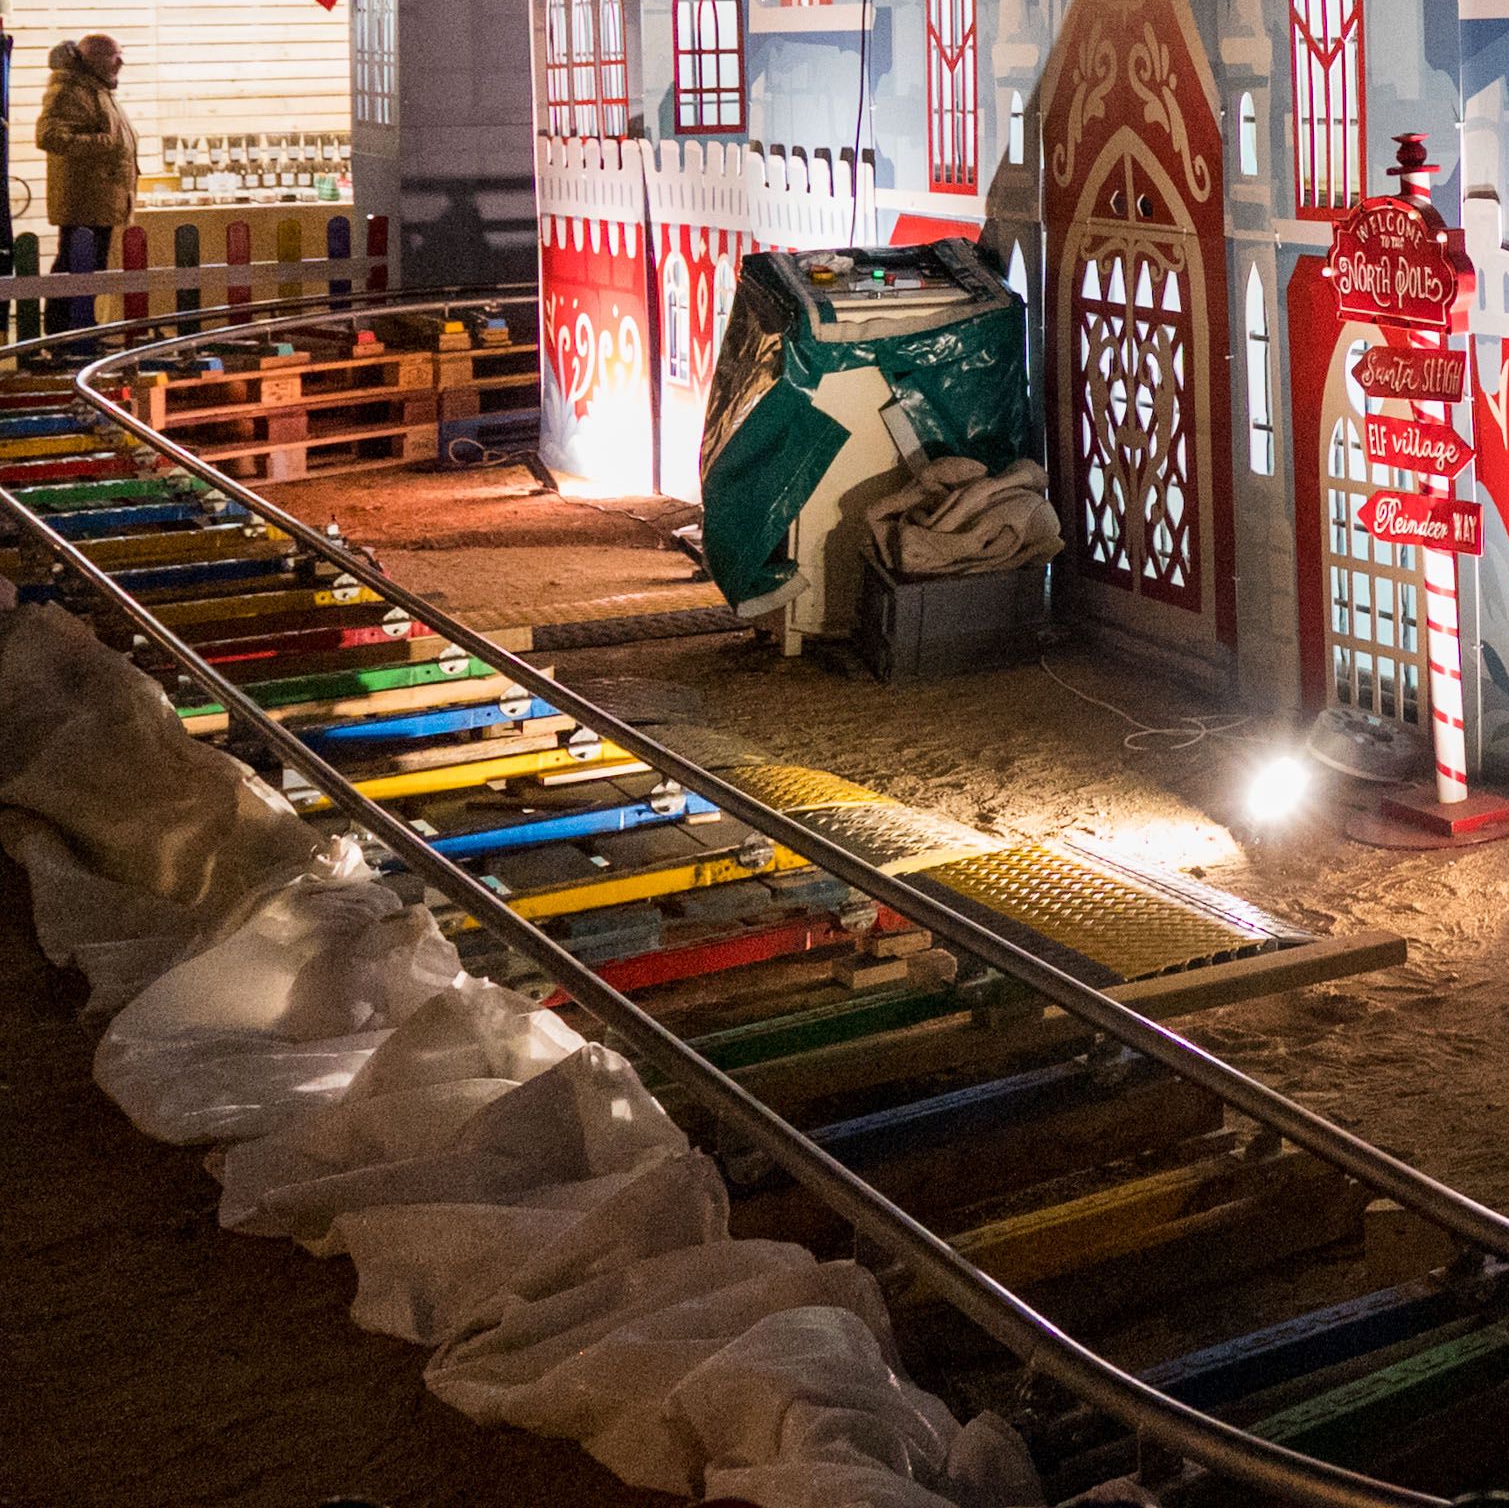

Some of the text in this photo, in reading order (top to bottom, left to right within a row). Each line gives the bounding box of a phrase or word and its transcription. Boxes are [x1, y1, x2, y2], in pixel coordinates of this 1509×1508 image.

[1356, 211, 1423, 249] WELCOME
[1394, 256, 1443, 309] POLE
[1361, 351, 1464, 395] Santa SLEIGH
[1368, 423, 1460, 470] ELF village
[1374, 497, 1477, 545] Reindeer WAY
